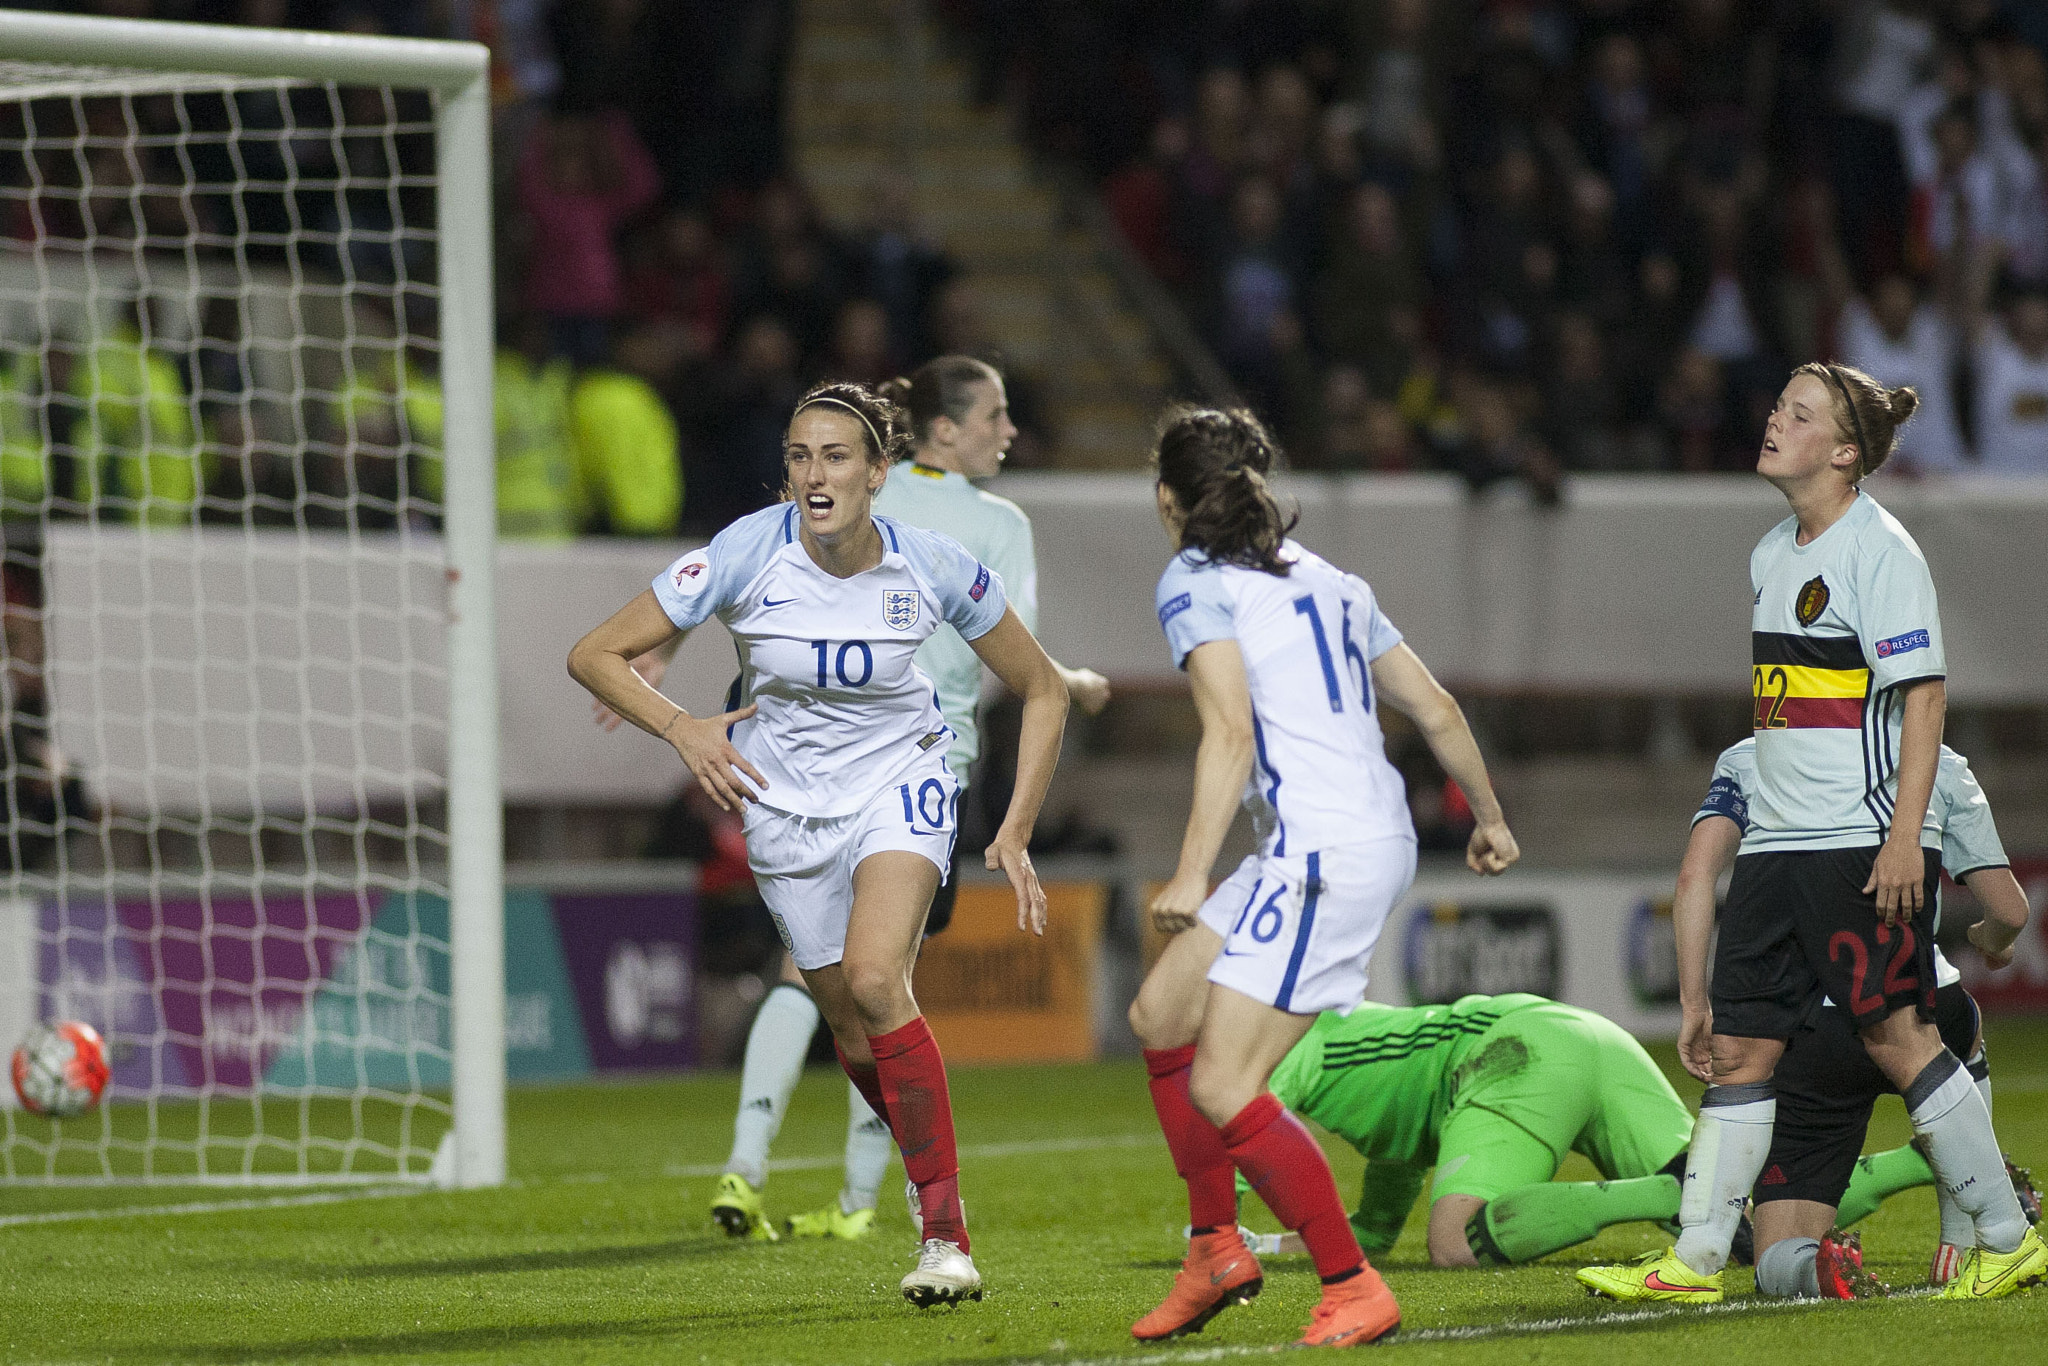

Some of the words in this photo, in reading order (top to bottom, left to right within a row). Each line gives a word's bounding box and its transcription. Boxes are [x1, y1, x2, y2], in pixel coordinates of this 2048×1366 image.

[811, 639, 873, 688] 10
[1293, 593, 1371, 714] 16
[1892, 634, 1929, 650] RESPECT
[1753, 666, 1787, 729] 22
[894, 778, 946, 828] 10
[1233, 879, 1287, 943] 16
[1829, 915, 1919, 1016] 22
